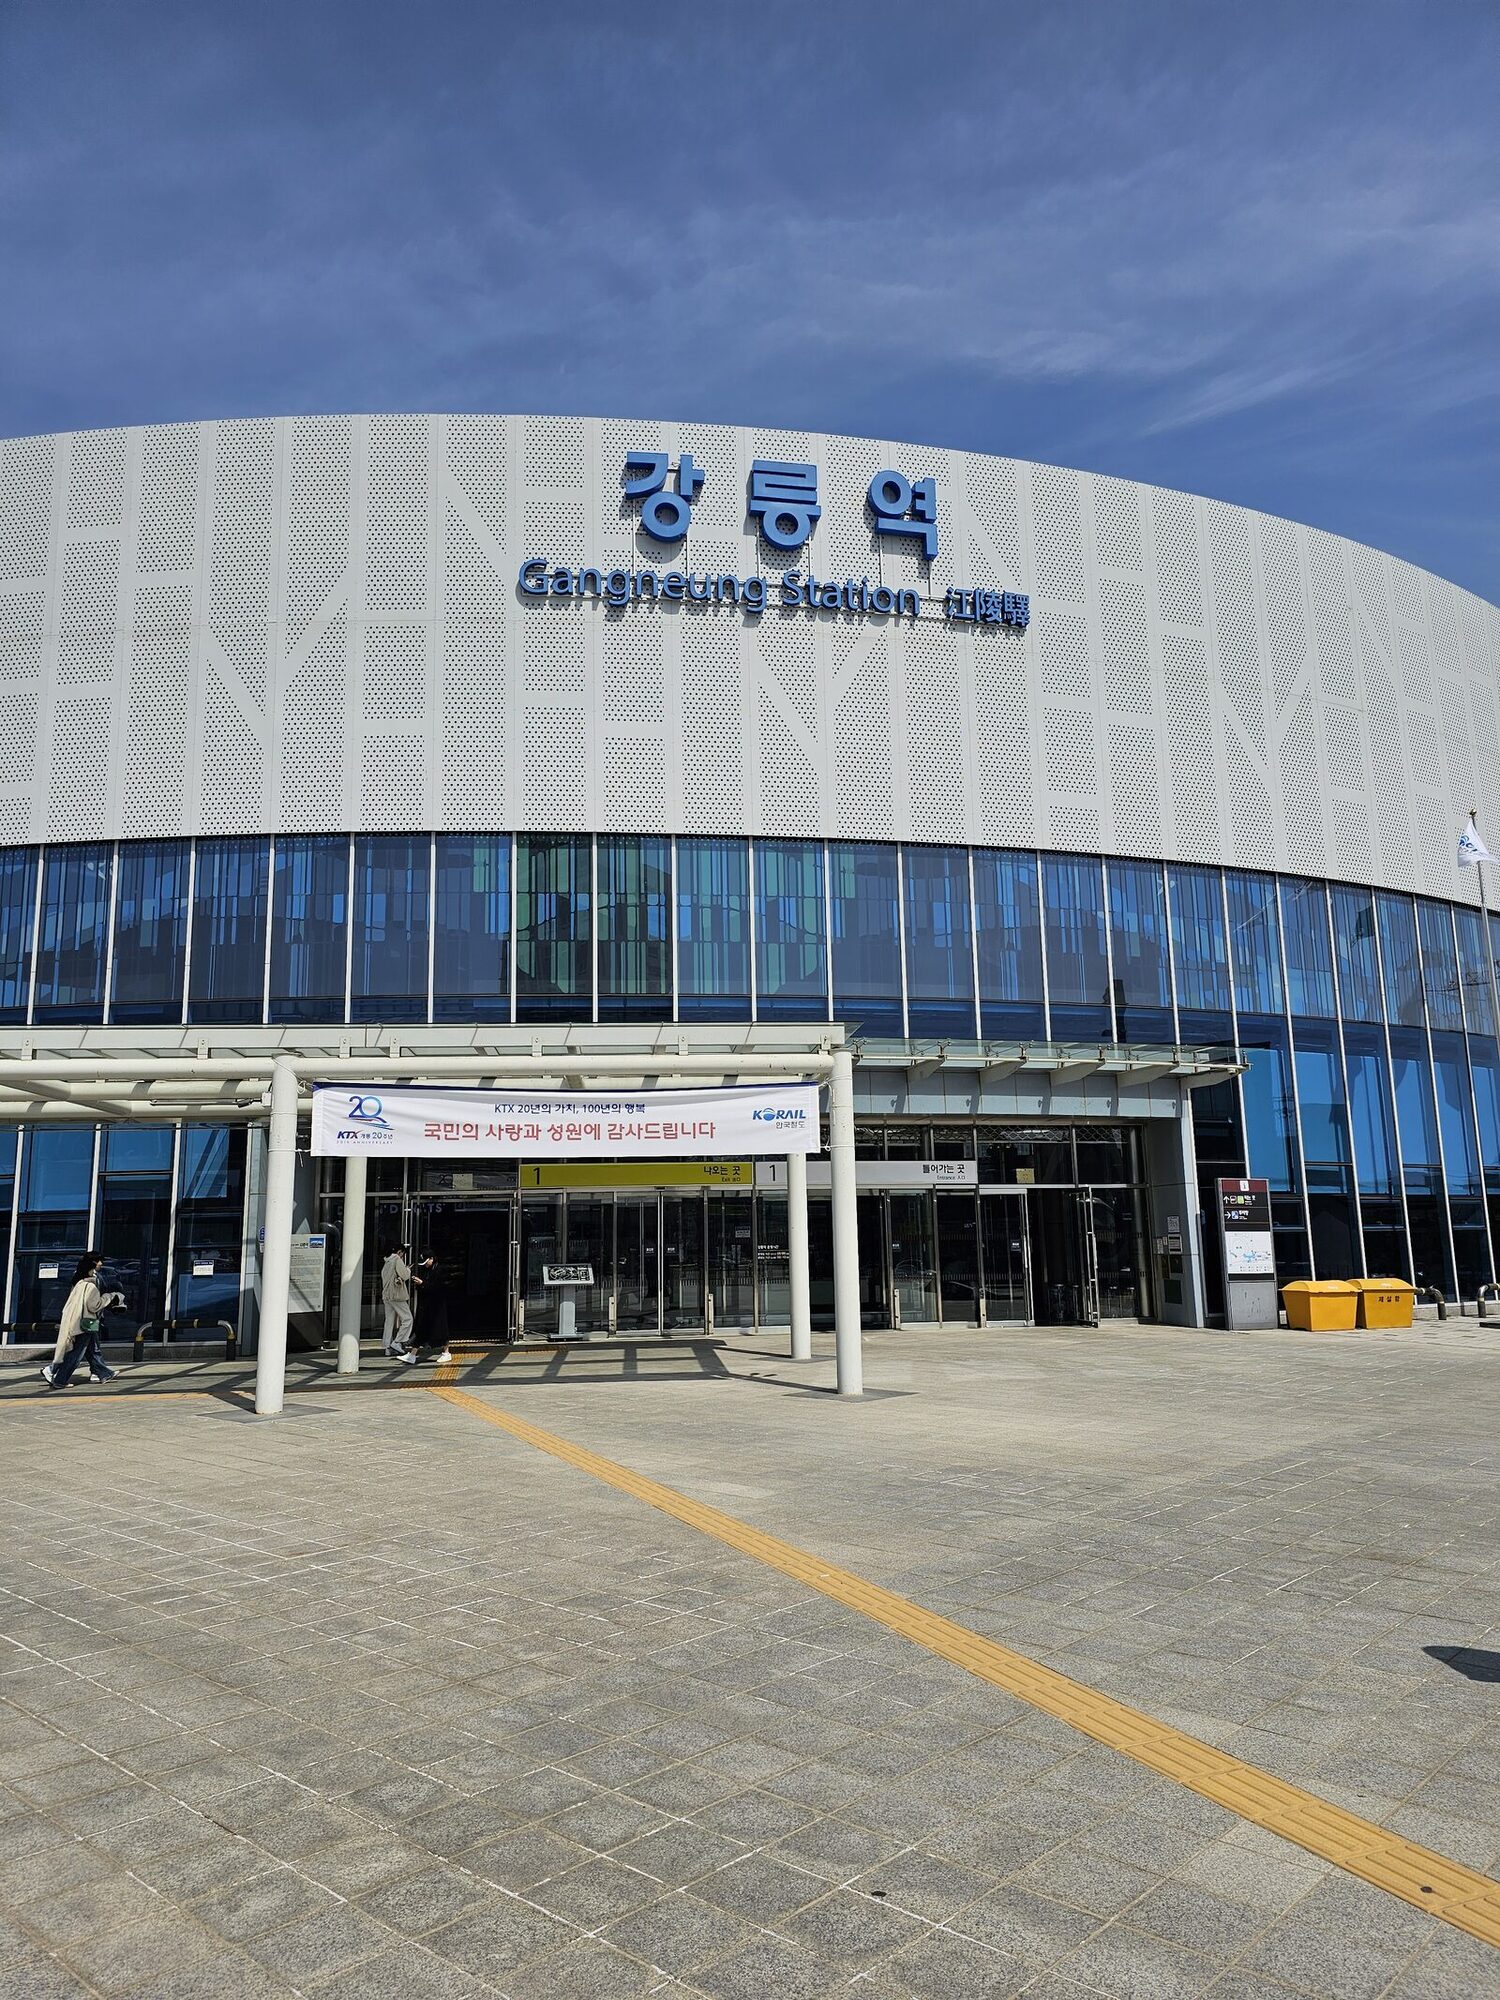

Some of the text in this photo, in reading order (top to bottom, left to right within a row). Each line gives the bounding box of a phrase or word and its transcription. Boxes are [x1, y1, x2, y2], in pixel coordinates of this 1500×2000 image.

[626, 451, 938, 561] 강릉역
[518, 558, 921, 616] Gangneung Station
[945, 586, 1031, 628] 江陵驛
[494, 1103, 646, 1115] KTX 20년의 가치, 100년의 행복
[752, 1107, 807, 1121] KORAIL
[337, 1131, 360, 1139] KTX
[424, 1122, 716, 1141] 국민의 사랑과 성원에 감사드립니다
[533, 1167, 541, 1185] 1
[704, 1165, 741, 1175] 나오는 곳
[769, 1164, 776, 1181] 1
[957, 1164, 965, 1174] 곳
